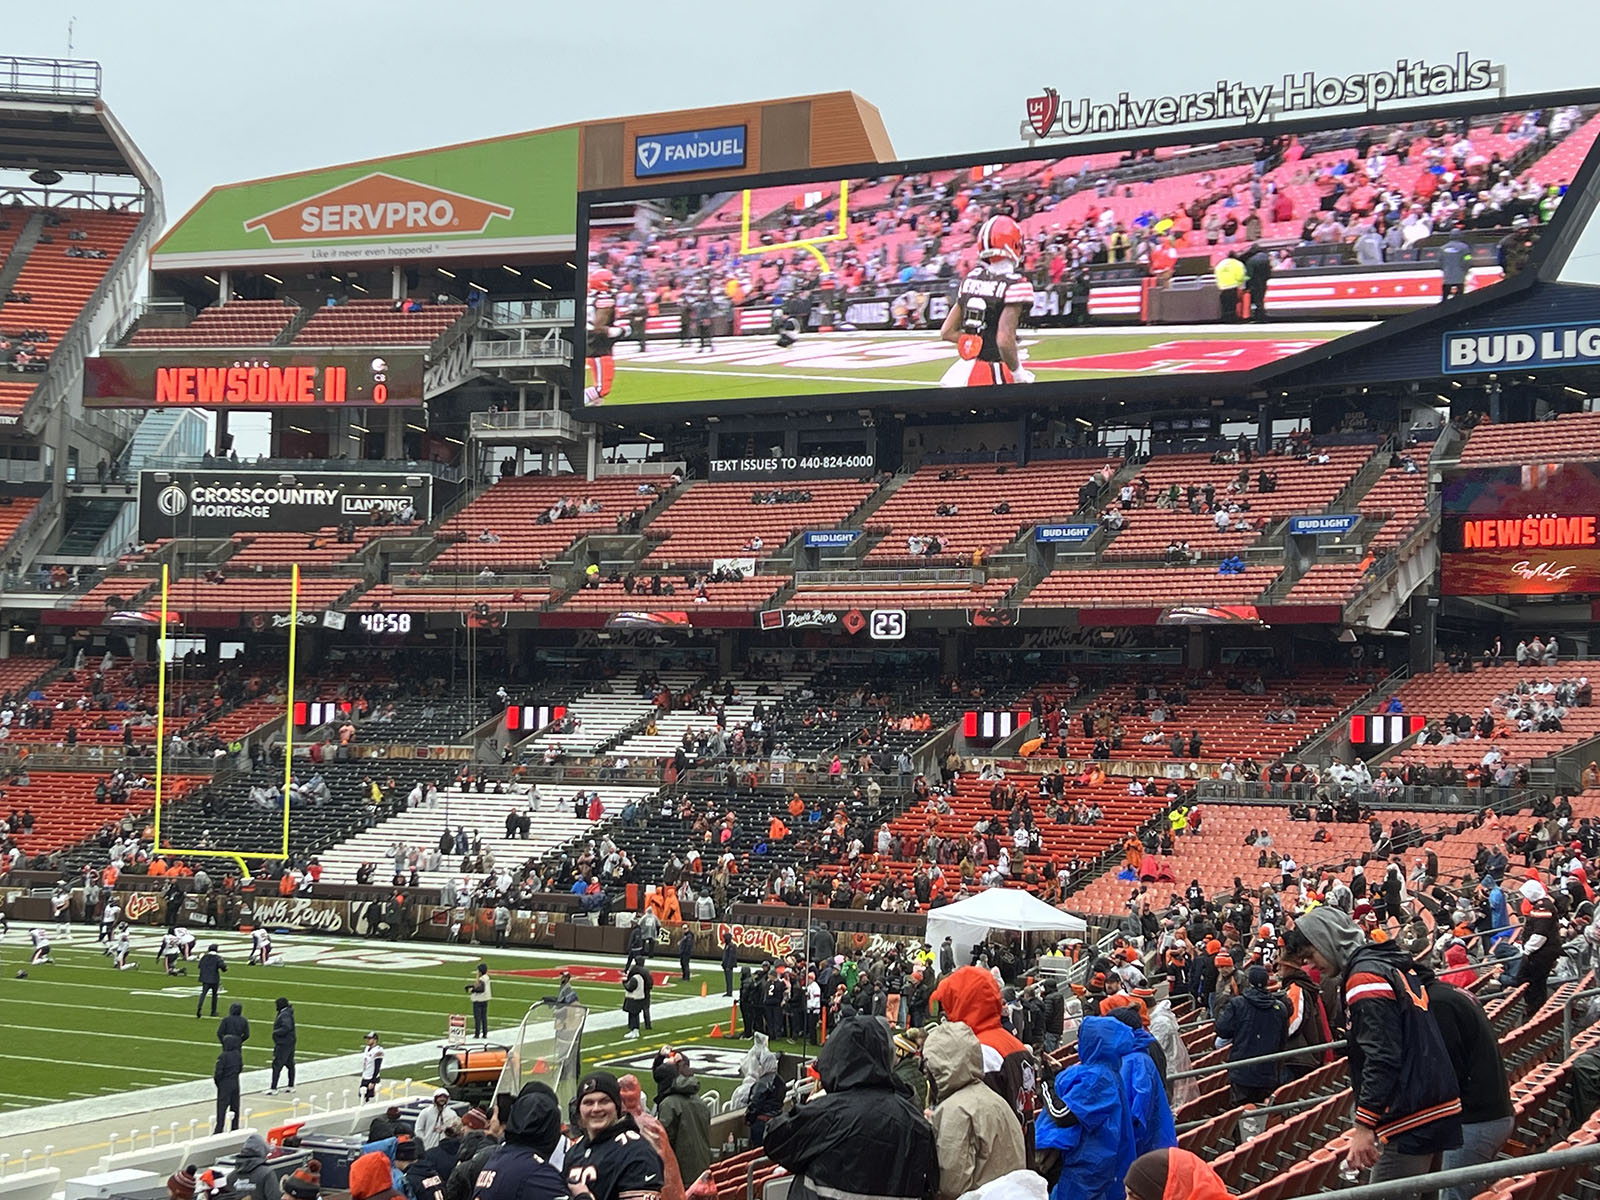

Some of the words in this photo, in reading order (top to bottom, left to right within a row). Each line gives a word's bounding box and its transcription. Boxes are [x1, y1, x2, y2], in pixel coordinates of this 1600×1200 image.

[1061, 79, 1273, 136] University
[1283, 51, 1493, 112] Hospitals
[664, 138, 743, 161] FANDUEL
[300, 199, 454, 233] SERVPRO
[311, 249, 329, 258] Like
[338, 249, 362, 257] never
[364, 248, 385, 256] even
[1450, 333, 1536, 366] BUD
[156, 367, 316, 402] NEWSOME
[324, 366, 347, 402] II
[373, 383, 387, 403] 0
[710, 459, 738, 472] TEXT
[740, 458, 777, 471] ISSUES
[781, 458, 796, 470] TO
[799, 455, 873, 469] 440-824-6000
[190, 487, 339, 505] CROSSCOUNTRY
[345, 498, 409, 511] LANDING
[192, 505, 270, 517] MORTGAGE
[1042, 529, 1062, 537] BUD
[1062, 528, 1089, 536] LIGHT
[1298, 520, 1319, 529] BUD
[1320, 519, 1350, 528] LIGHT
[1463, 516, 1597, 549] NEWSOME
[811, 534, 829, 542] BUD
[829, 533, 853, 541] LIGHT
[360, 613, 411, 632] 40:58
[875, 614, 901, 635] 25
